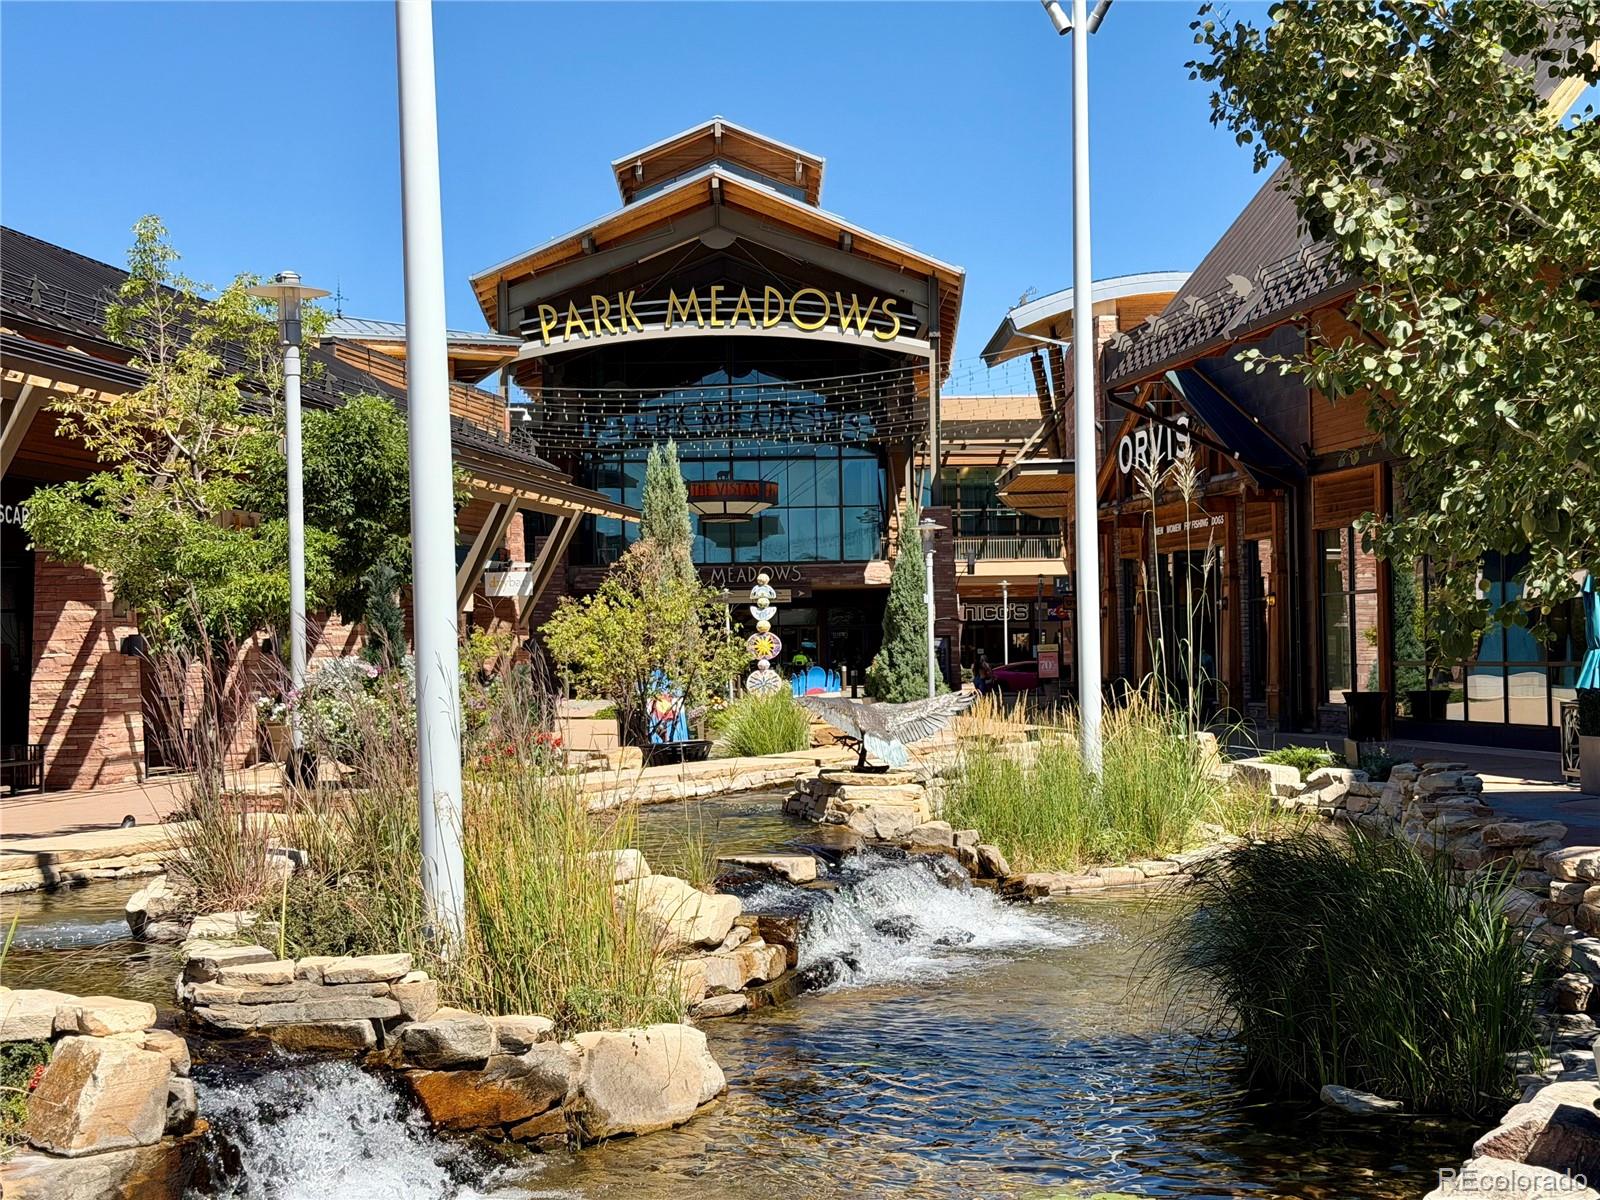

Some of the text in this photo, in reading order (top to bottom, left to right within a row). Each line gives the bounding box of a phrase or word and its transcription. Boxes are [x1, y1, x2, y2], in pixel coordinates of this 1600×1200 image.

[538, 285, 900, 345] PARK MEADOWS
[1119, 416, 1190, 474] ORVIS
[1211, 514, 1225, 526] DOGS
[711, 565, 801, 584] MEADOWS
